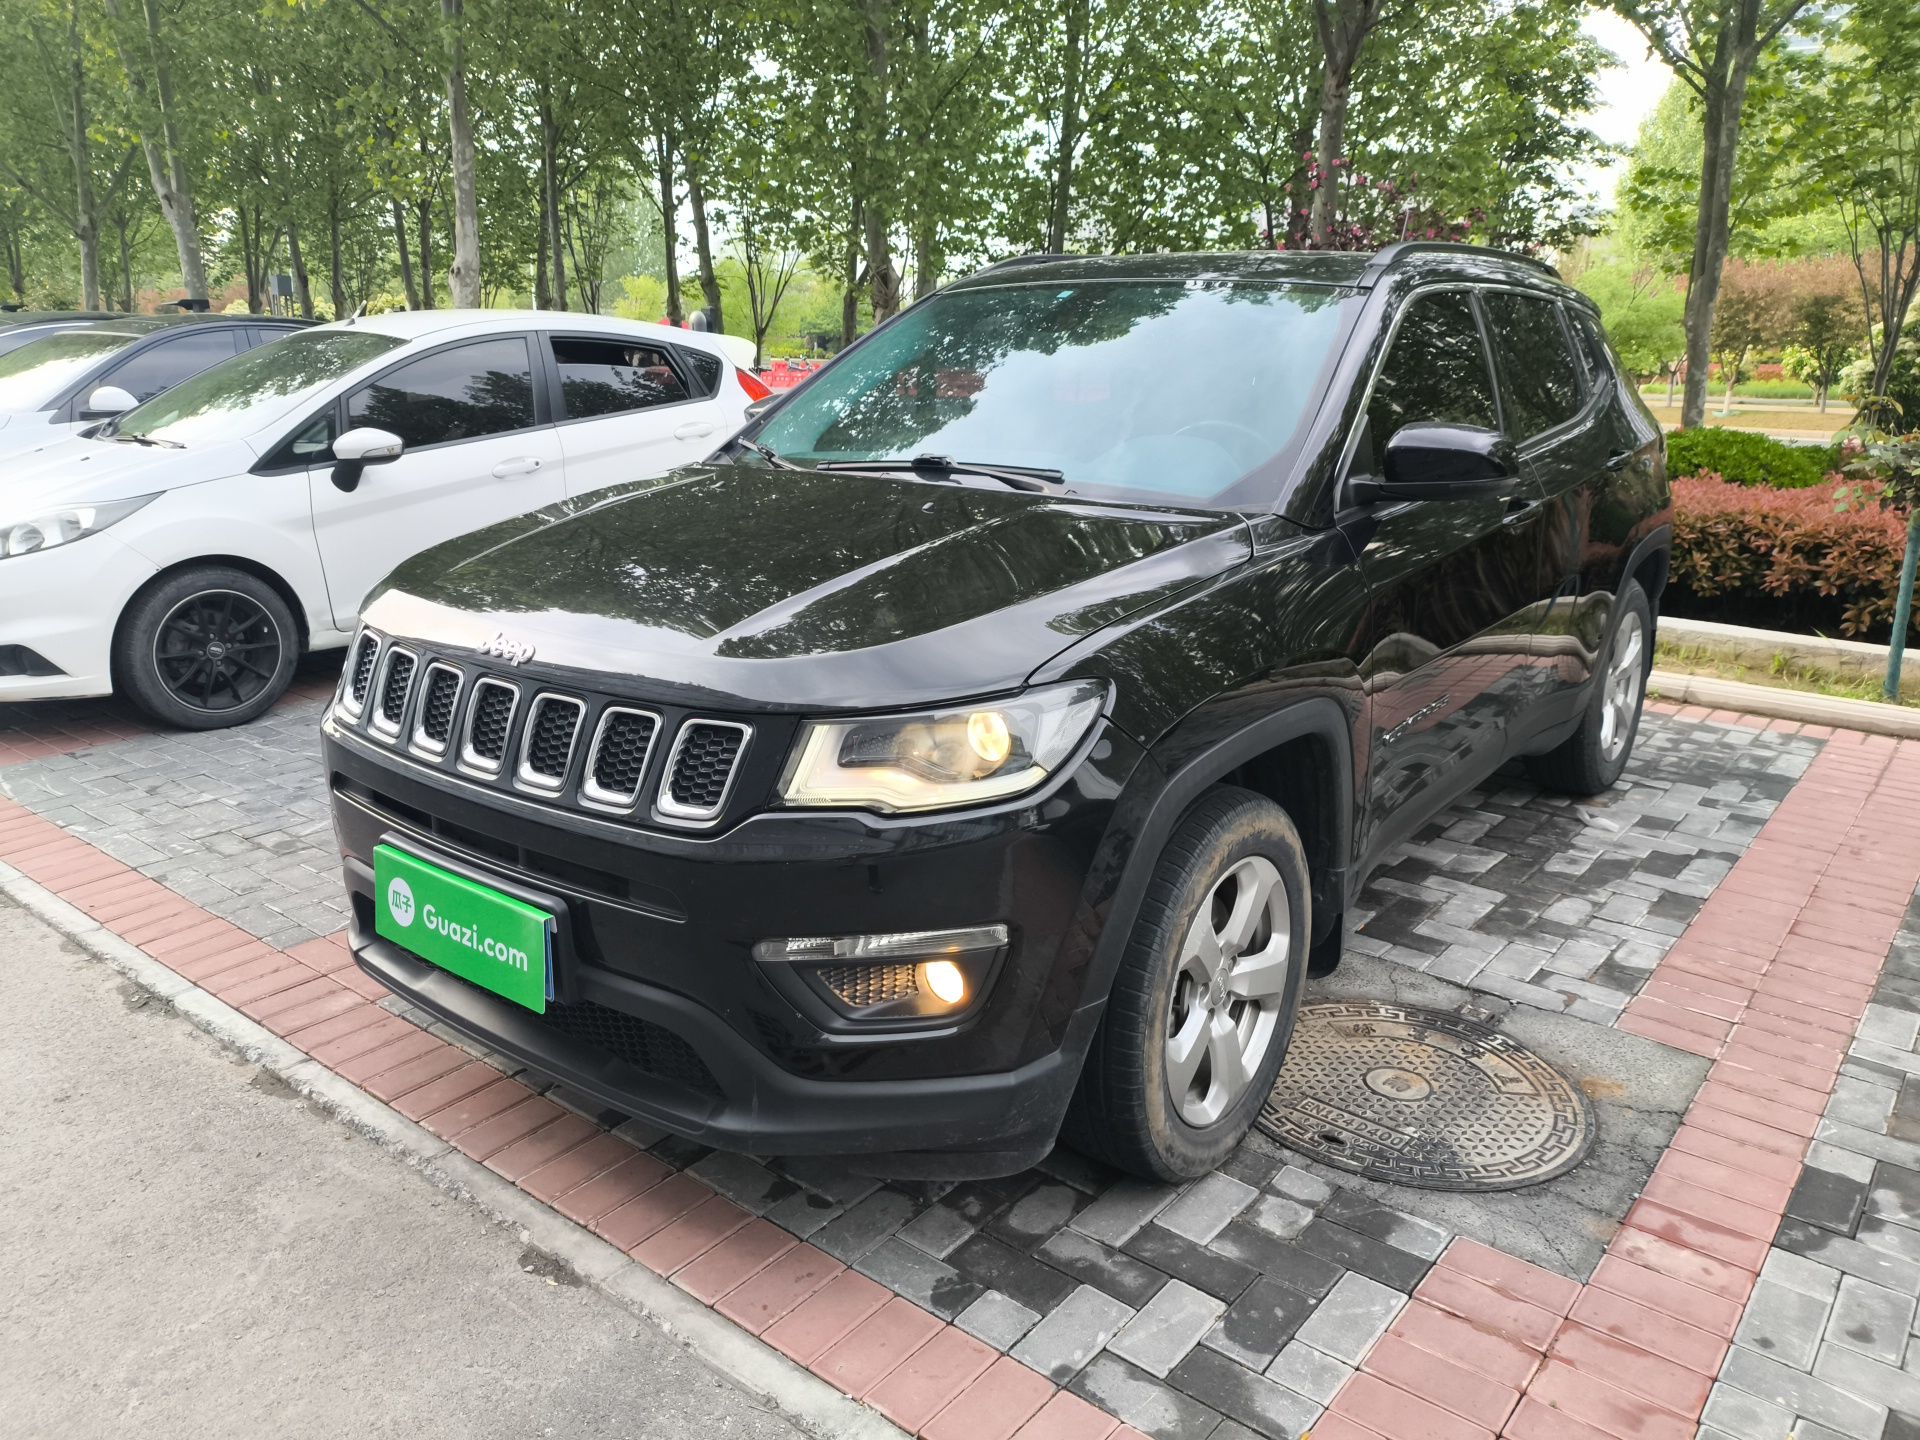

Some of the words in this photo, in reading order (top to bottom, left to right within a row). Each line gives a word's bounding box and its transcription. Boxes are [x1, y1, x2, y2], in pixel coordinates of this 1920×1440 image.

[476, 630, 536, 667] Jeep
[391, 889, 412, 913] 瓜子
[423, 904, 528, 972] Guazi.com
